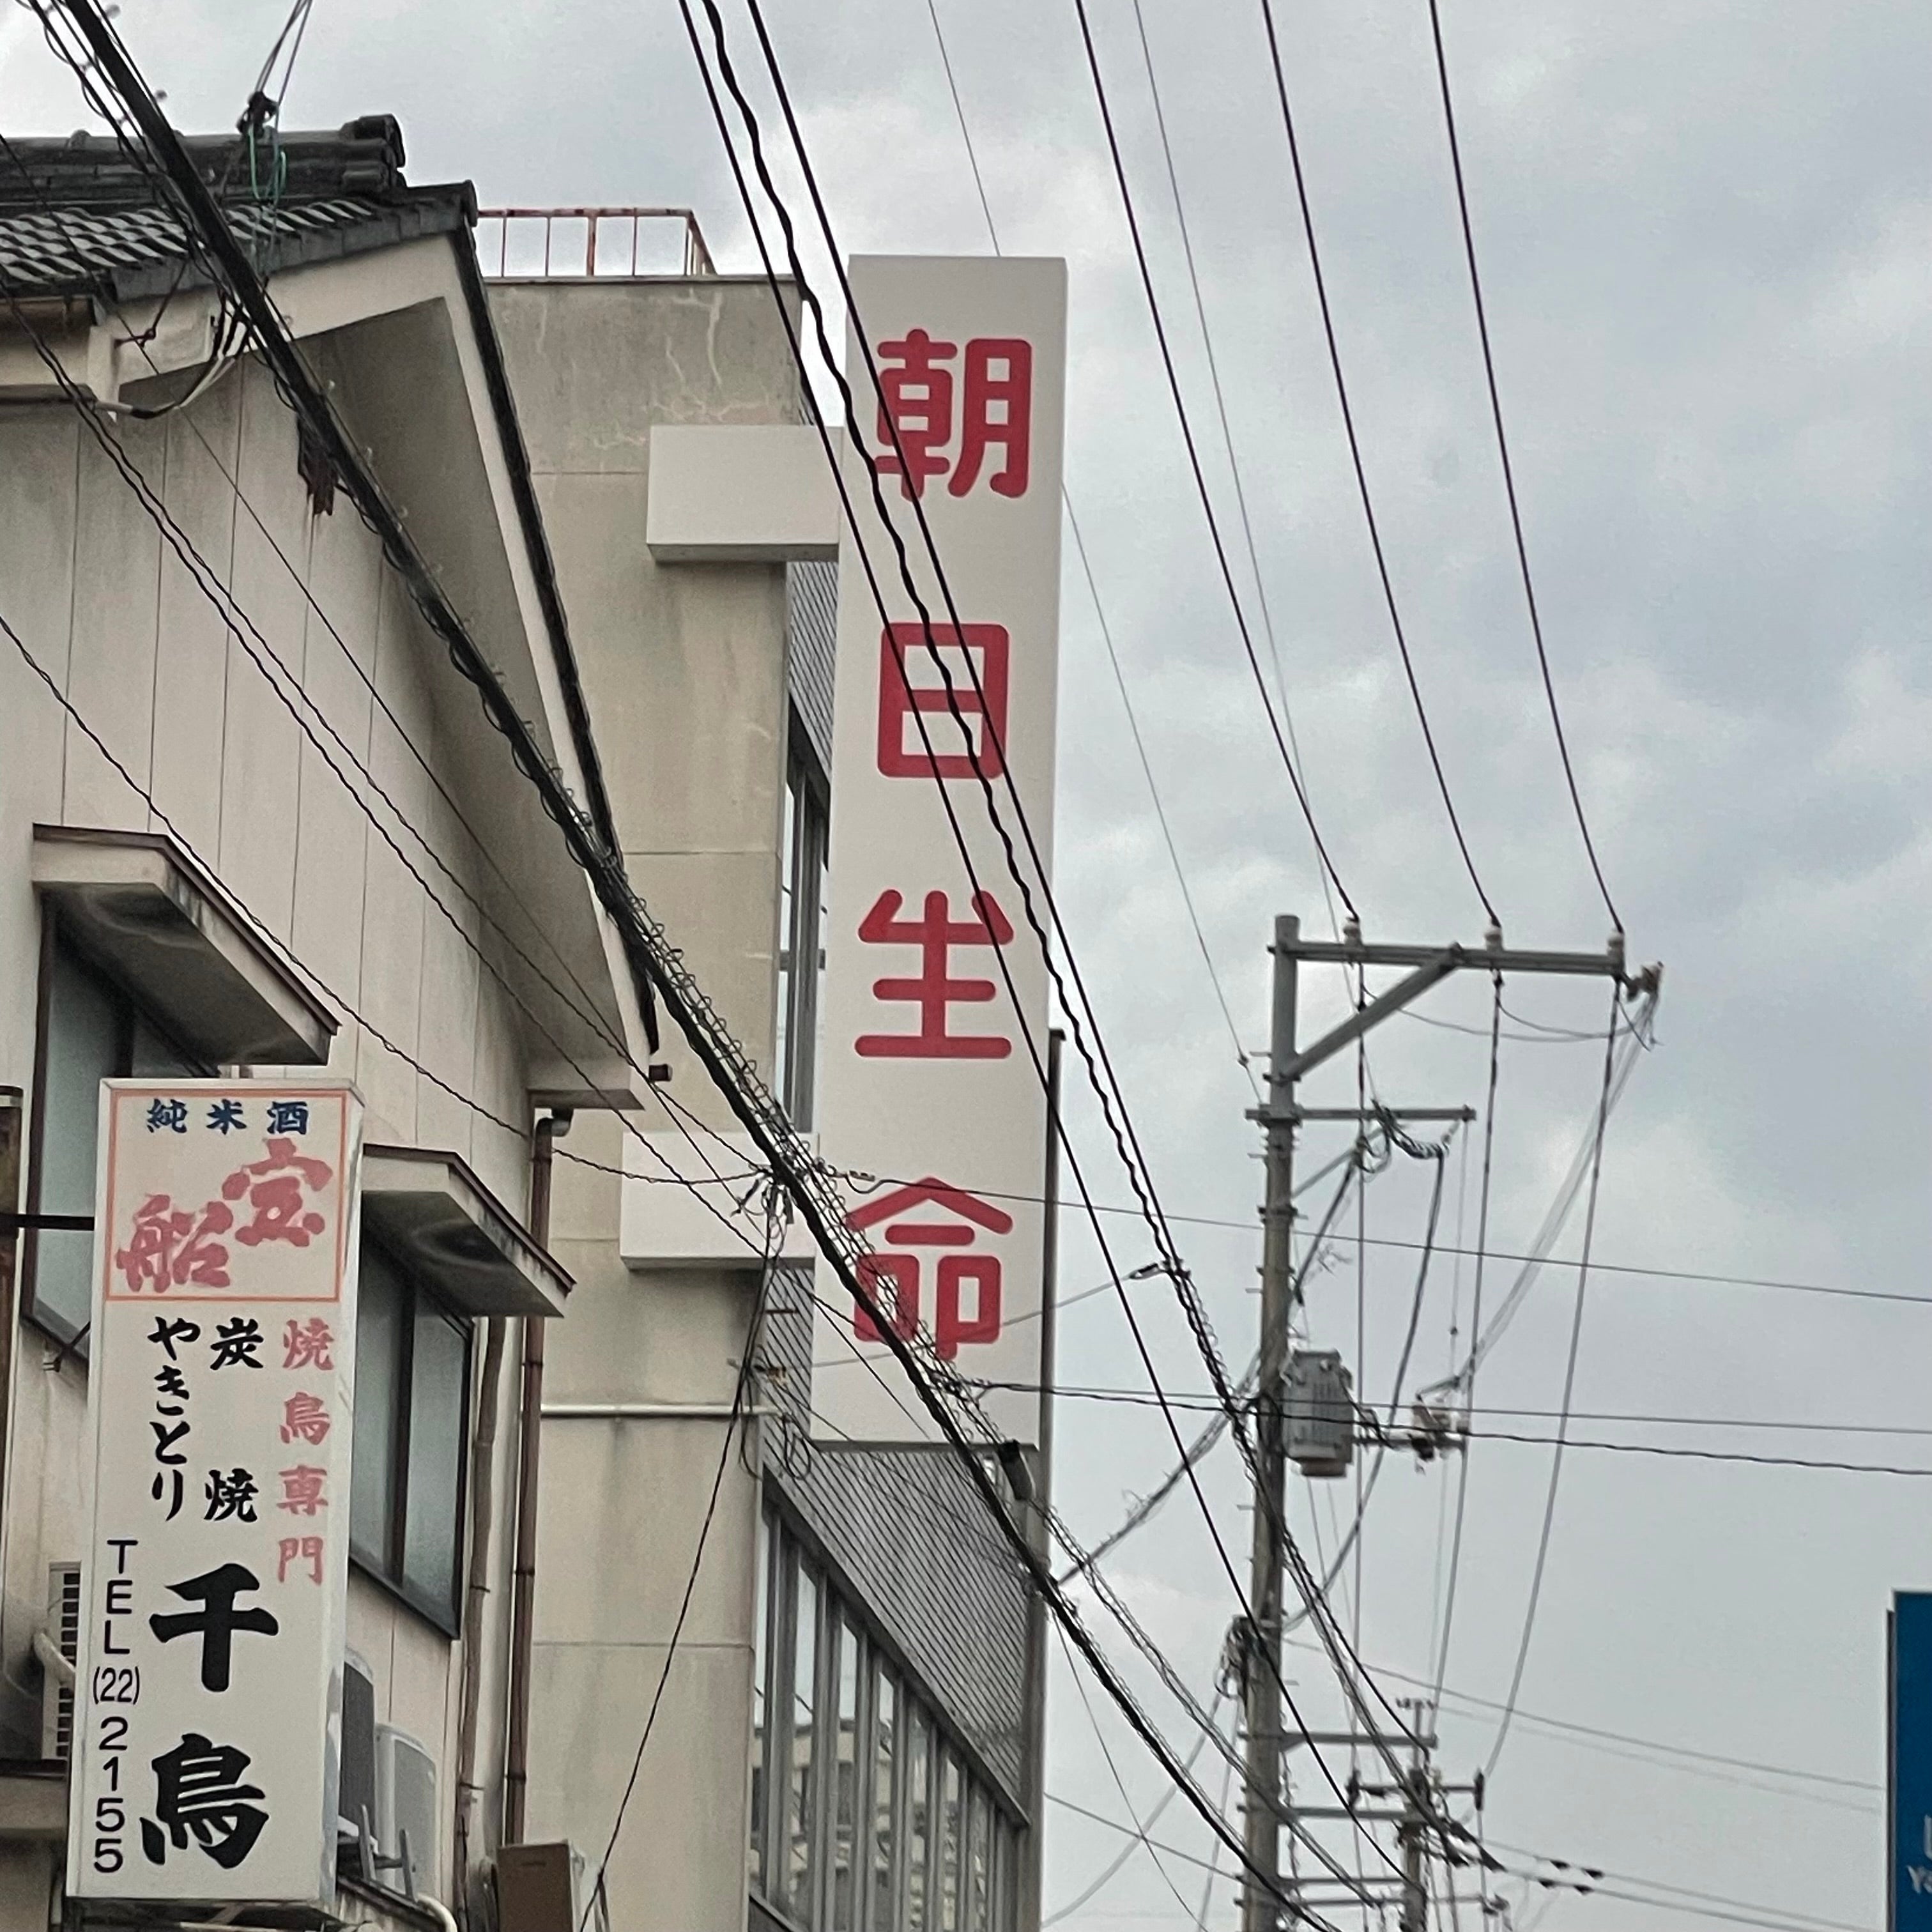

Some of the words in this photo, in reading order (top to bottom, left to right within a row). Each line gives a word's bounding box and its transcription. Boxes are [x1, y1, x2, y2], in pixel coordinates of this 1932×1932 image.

[848, 328, 1032, 1362] 朝日生命
[146, 1098, 308, 1135] 純米酒
[147, 1315, 201, 1522] やきとり
[276, 1317, 335, 1584] 焼鳥専門
[139, 1562, 279, 1869] 千鳥
